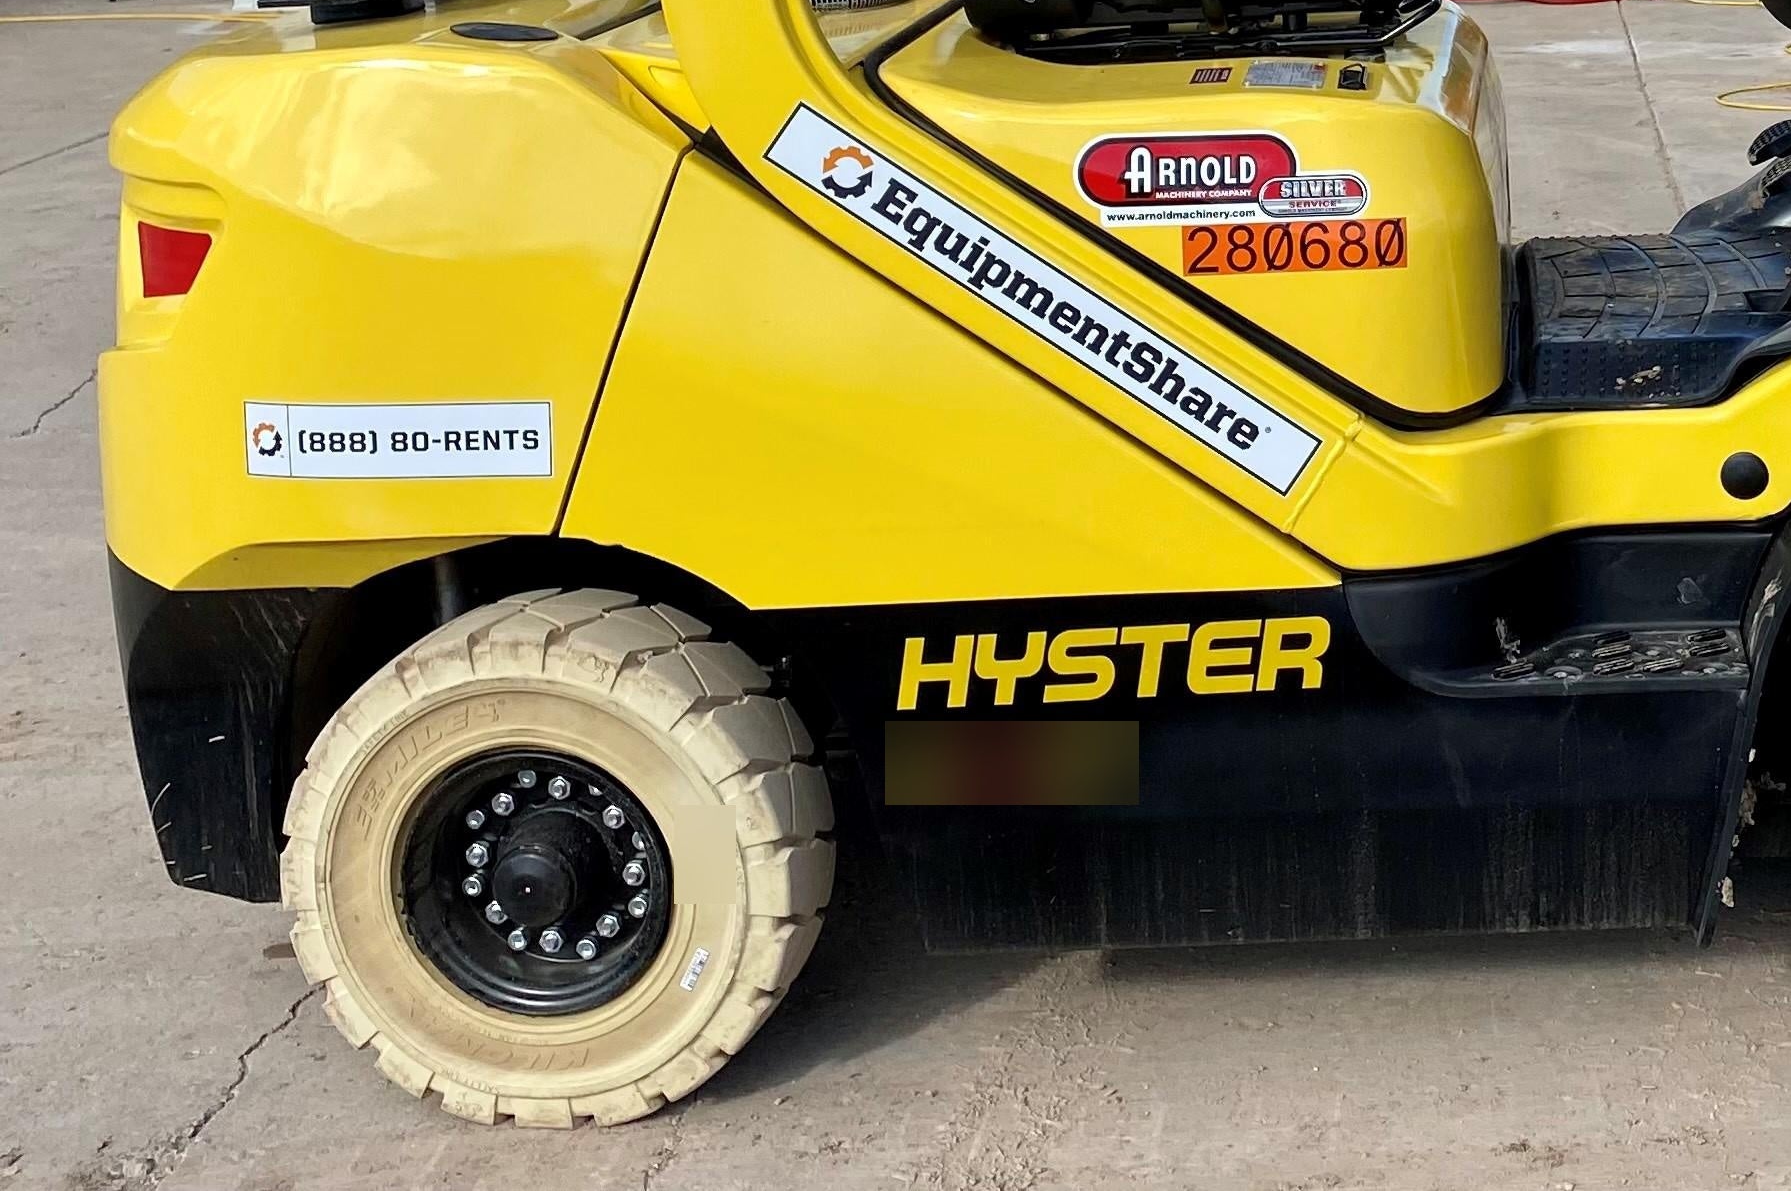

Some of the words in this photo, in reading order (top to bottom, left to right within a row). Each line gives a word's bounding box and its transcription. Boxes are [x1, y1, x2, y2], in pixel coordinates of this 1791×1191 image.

[1124, 146, 1257, 194] ARNOLD
[1155, 189, 1208, 200] MACHINERY
[1208, 188, 1253, 199] COMPANY
[1280, 179, 1347, 198] SILVER
[1106, 208, 1257, 222] www.arnoldmachinery.com
[1289, 200, 1338, 209] SERVICE
[1186, 219, 1404, 274] 280680
[870, 176, 1262, 452] EquipmentShare
[297, 429, 379, 455] (888)
[390, 428, 541, 453] 80-RENTS
[896, 615, 1332, 711] HYSTER
